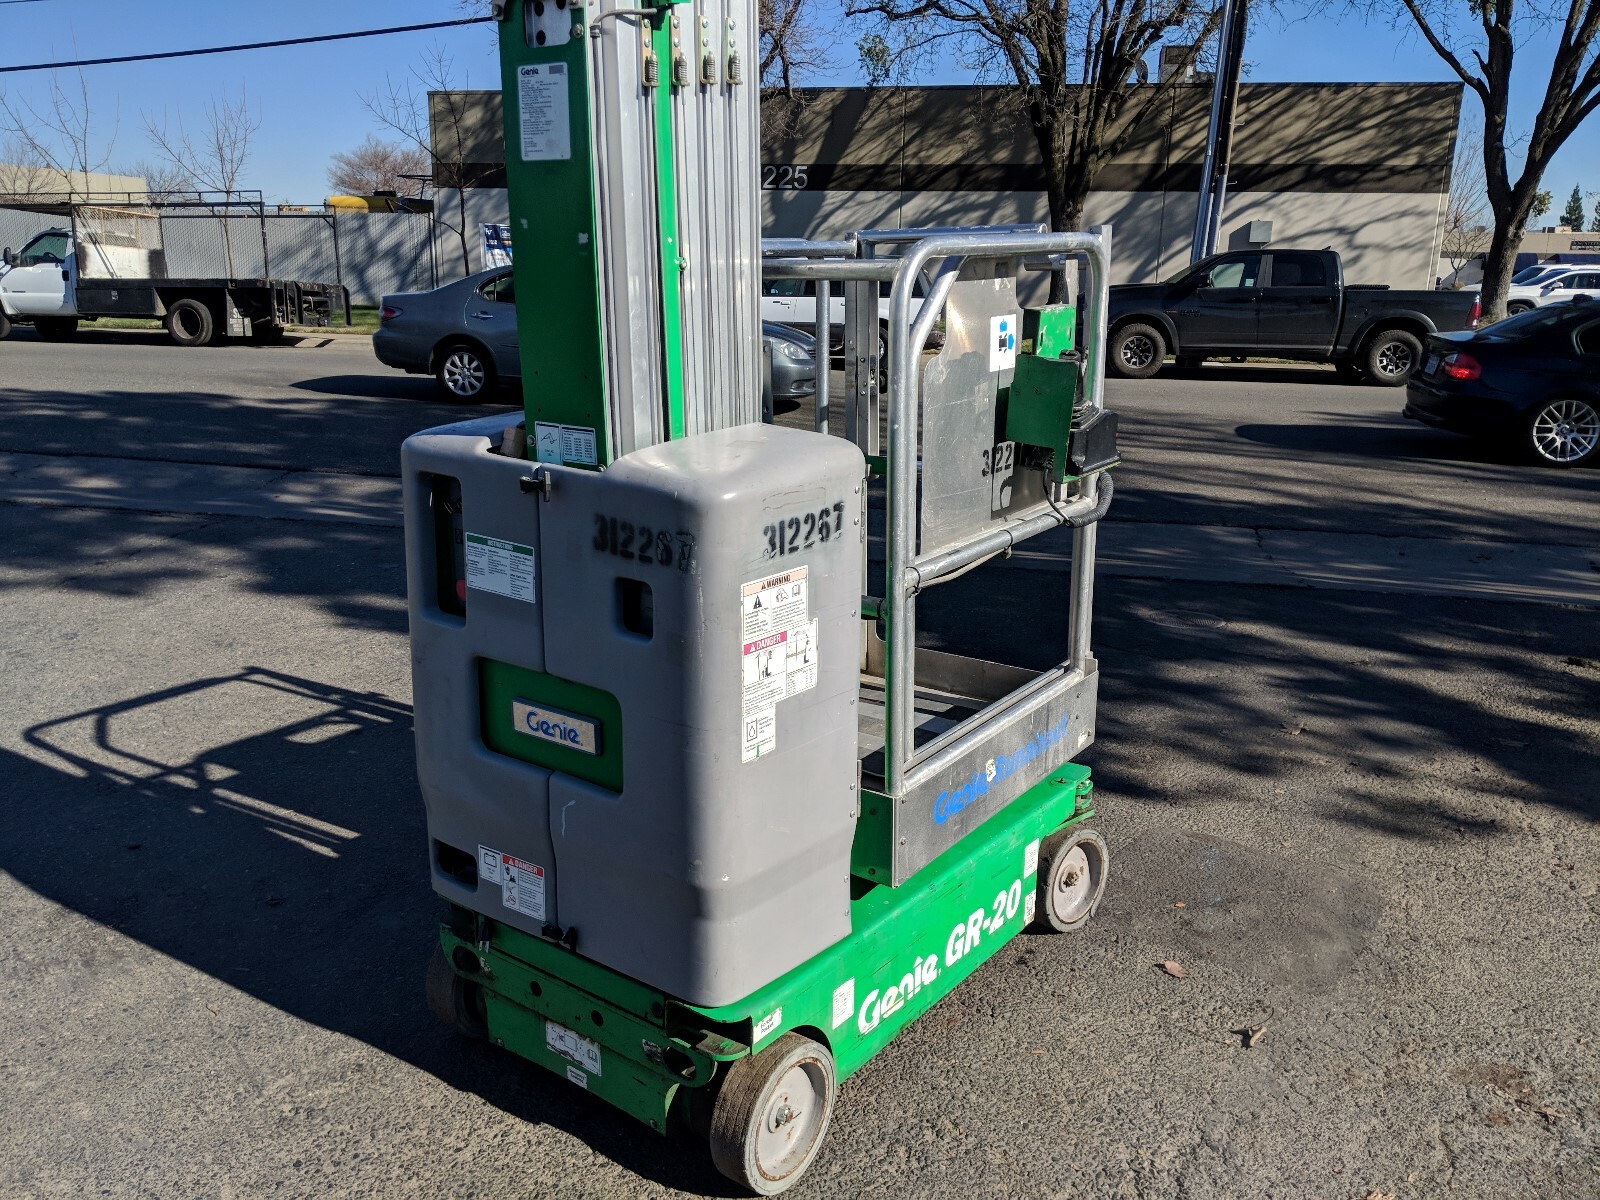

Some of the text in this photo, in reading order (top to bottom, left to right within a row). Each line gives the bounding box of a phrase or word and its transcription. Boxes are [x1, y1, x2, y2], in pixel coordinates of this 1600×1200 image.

[520, 67, 539, 76] Genie
[762, 165, 808, 189] 225
[593, 513, 694, 571] 312267
[763, 501, 844, 560] 312267
[767, 574, 790, 588] WARNING
[756, 634, 781, 650] DANGER
[526, 711, 580, 745] Genie
[514, 860, 538, 875] DANGER
[857, 879, 1022, 1035] Genie GR-20
